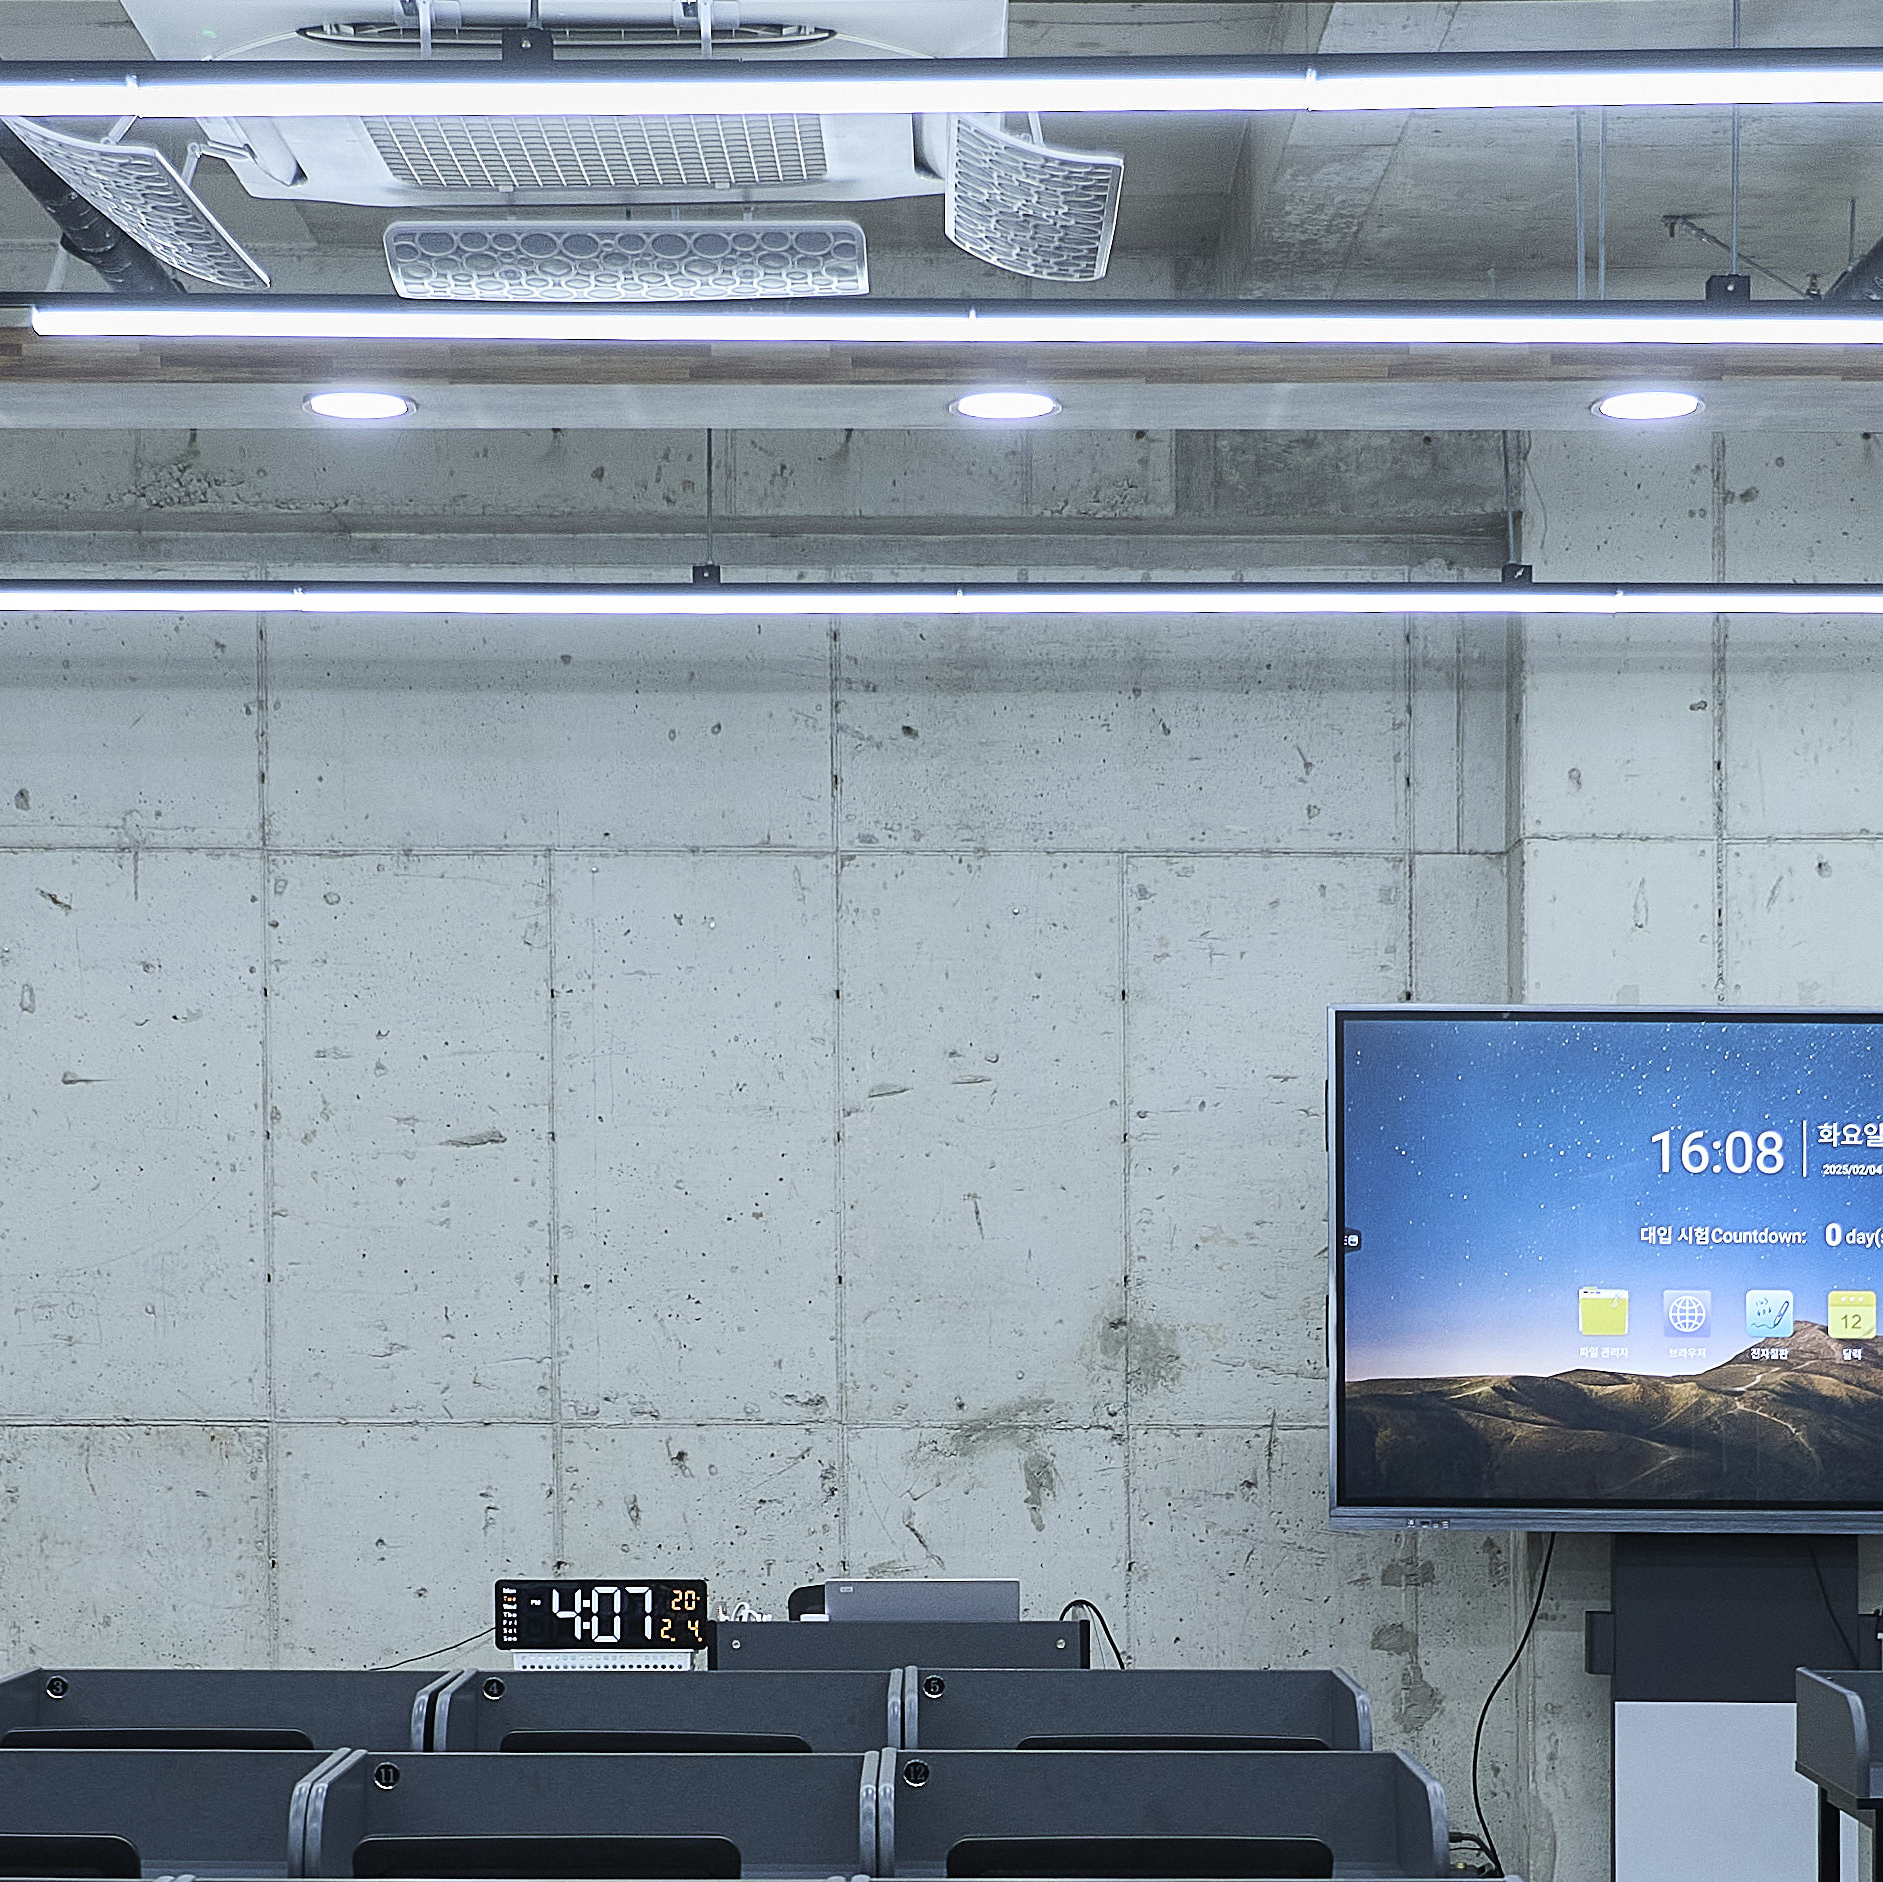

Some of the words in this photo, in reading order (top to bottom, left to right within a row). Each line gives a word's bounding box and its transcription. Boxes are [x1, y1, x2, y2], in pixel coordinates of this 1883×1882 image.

[1651, 1130, 1785, 1174] 16:08
[1822, 1164, 1883, 1176] 2025/02/04
[1640, 1226, 1673, 1245] 대입
[1824, 1222, 1842, 1247] 0
[1840, 1314, 1863, 1330] 12
[552, 1586, 653, 1643] 4:07
[52, 1681, 62, 1693] 3
[489, 1683, 500, 1695] 4
[929, 1681, 939, 1693] 5
[378, 1768, 395, 1782] 11
[908, 1766, 925, 1781] 12
